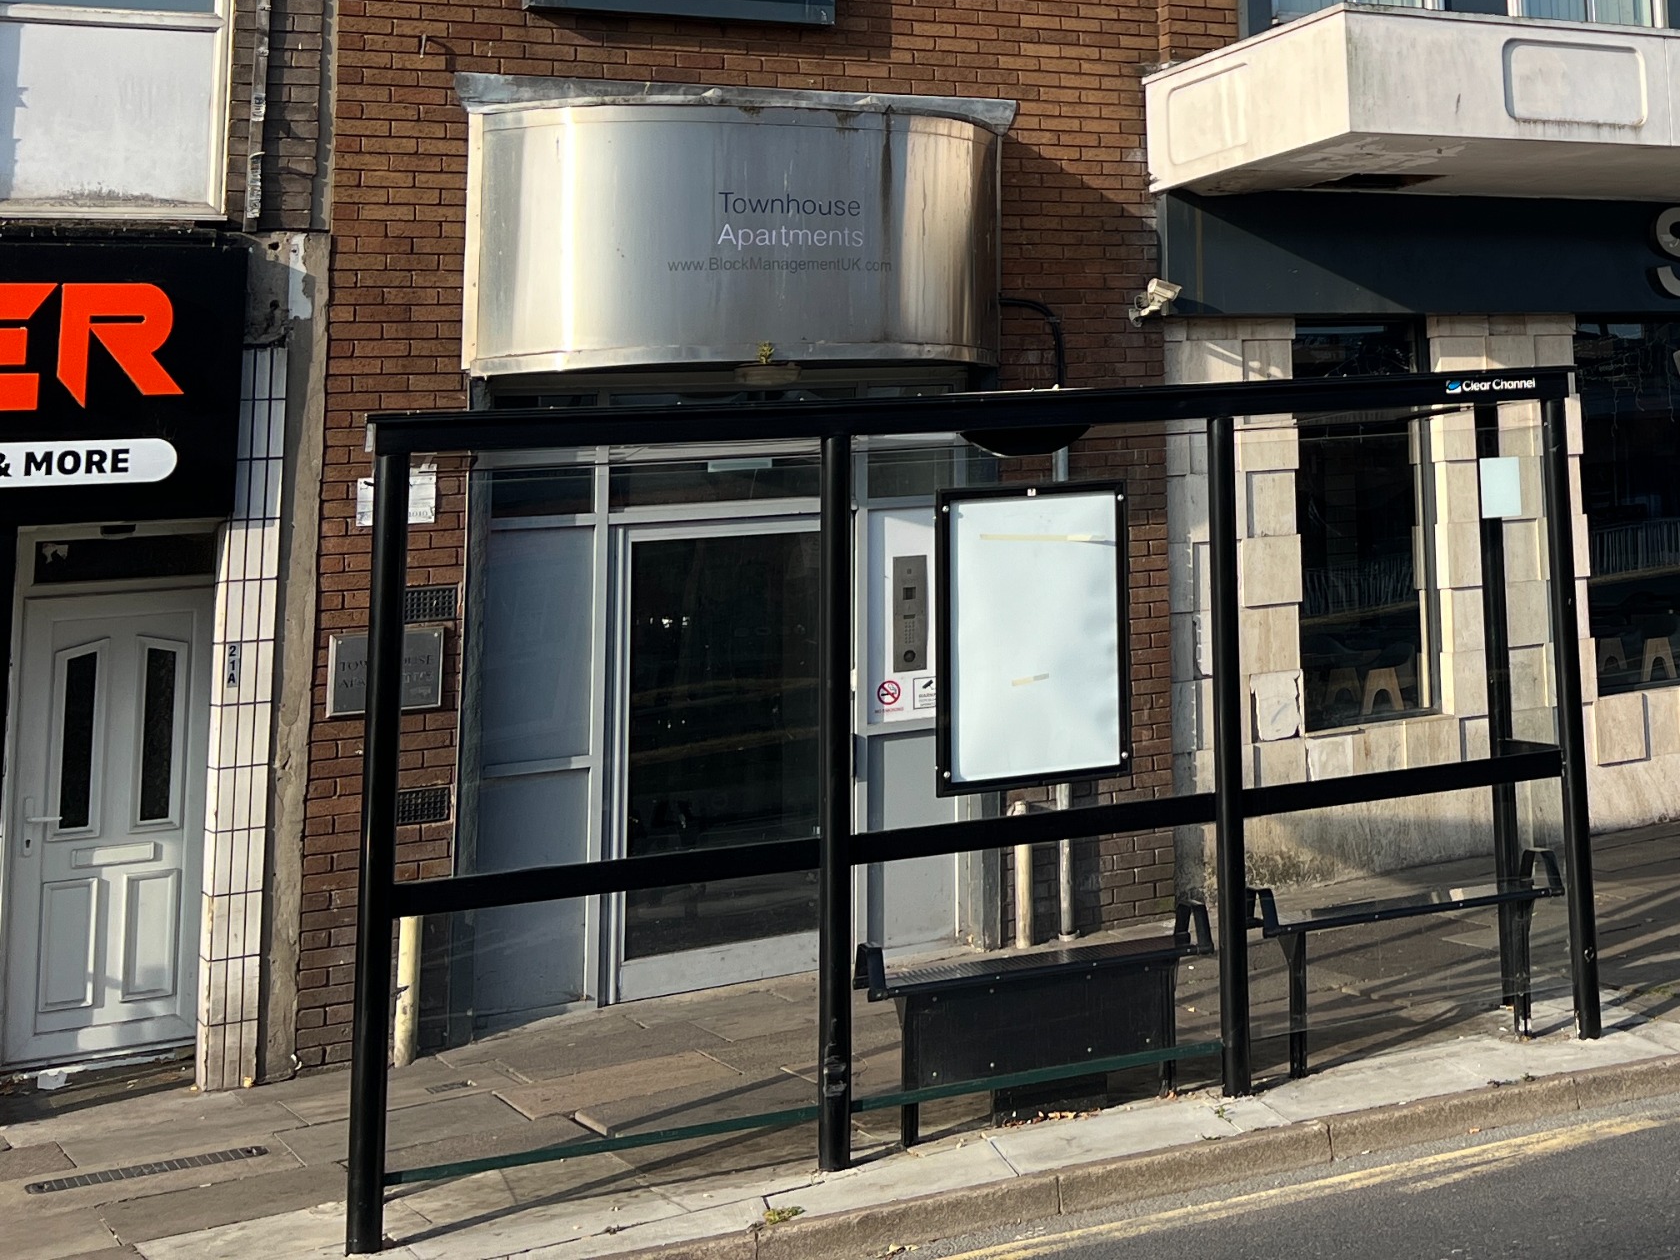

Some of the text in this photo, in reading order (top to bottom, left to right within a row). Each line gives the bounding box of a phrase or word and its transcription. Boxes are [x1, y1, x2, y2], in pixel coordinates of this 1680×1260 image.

[718, 191, 861, 217] Townhouse
[717, 223, 864, 251] Apartments
[667, 256, 892, 274] www.BlockManagementUK.com
[1462, 377, 1536, 392] Clear Channel
[23, 448, 130, 477] MORE
